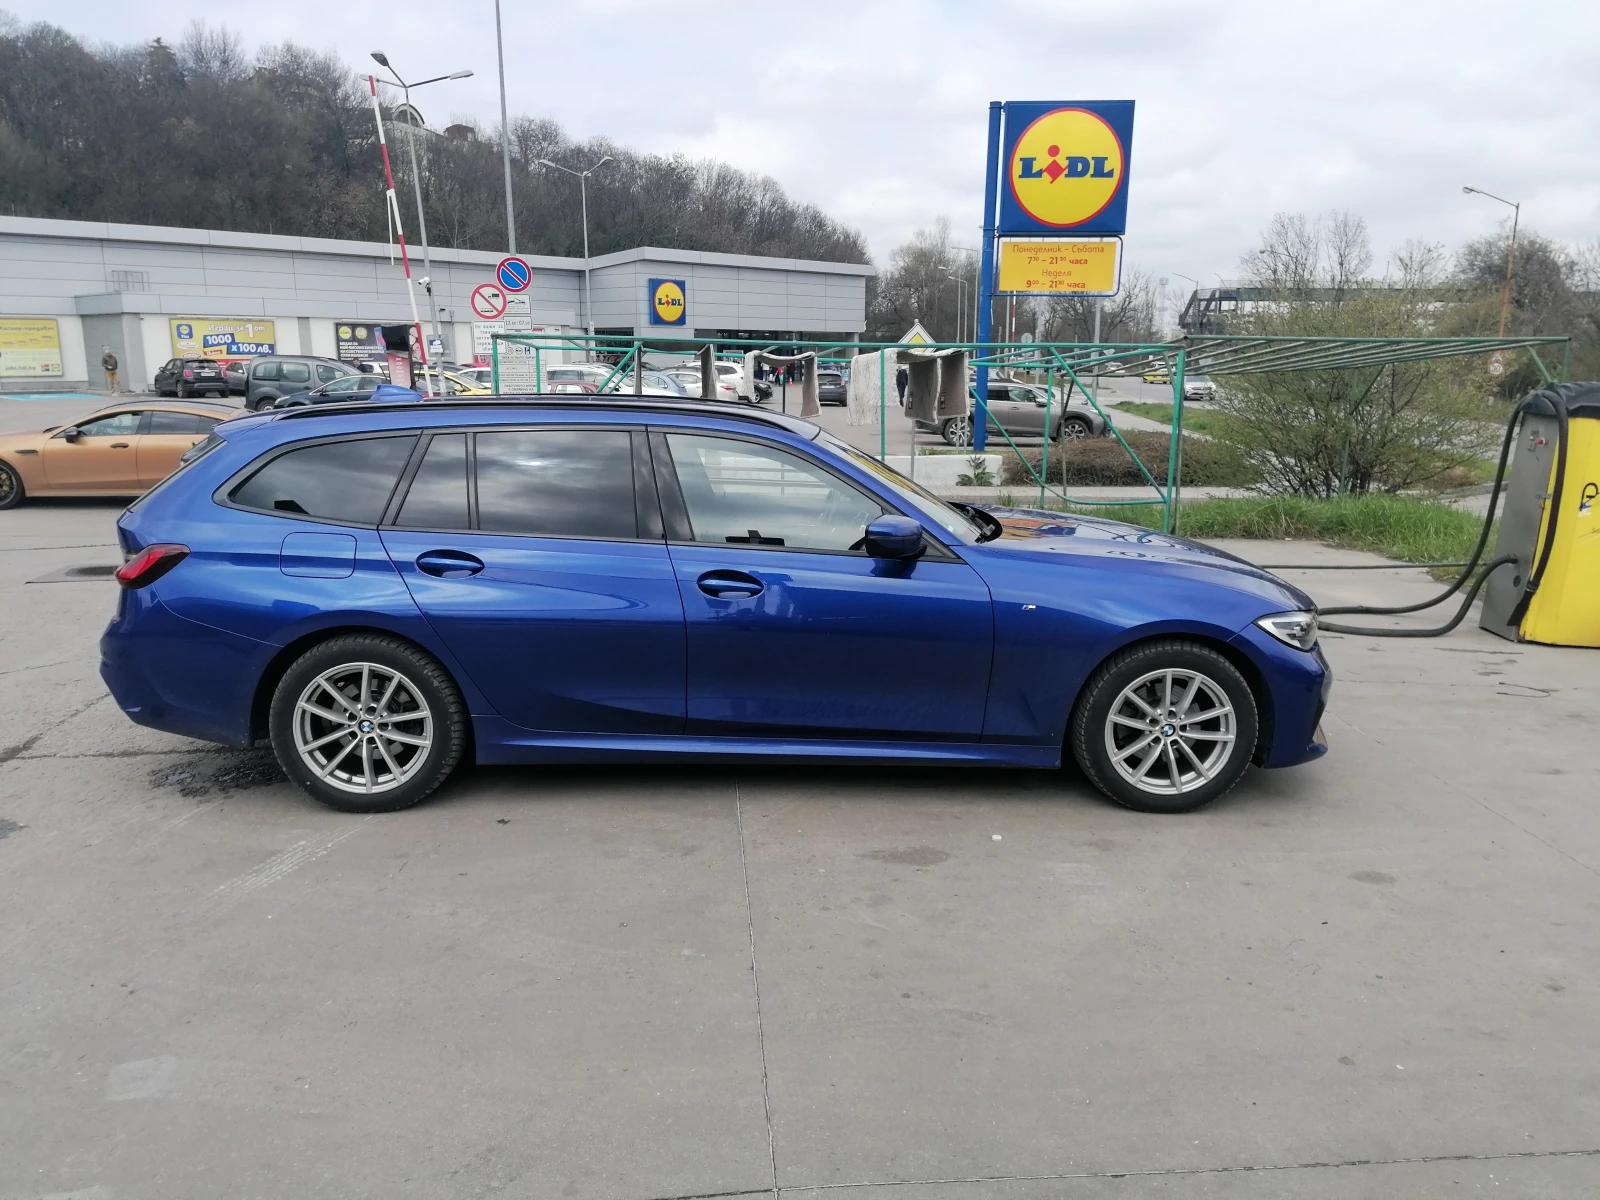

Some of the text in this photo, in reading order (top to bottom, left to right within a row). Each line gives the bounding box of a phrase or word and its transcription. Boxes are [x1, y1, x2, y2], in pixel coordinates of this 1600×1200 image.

[1018, 144, 1114, 184] LIDL
[1013, 245, 1062, 255] Понеделник
[1072, 244, 1105, 253] Събота
[1042, 269, 1072, 279] Неделя
[657, 294, 683, 308] LIDL
[208, 324, 234, 333] Играй
[245, 323, 254, 338] 1
[206, 334, 232, 345] 1000
